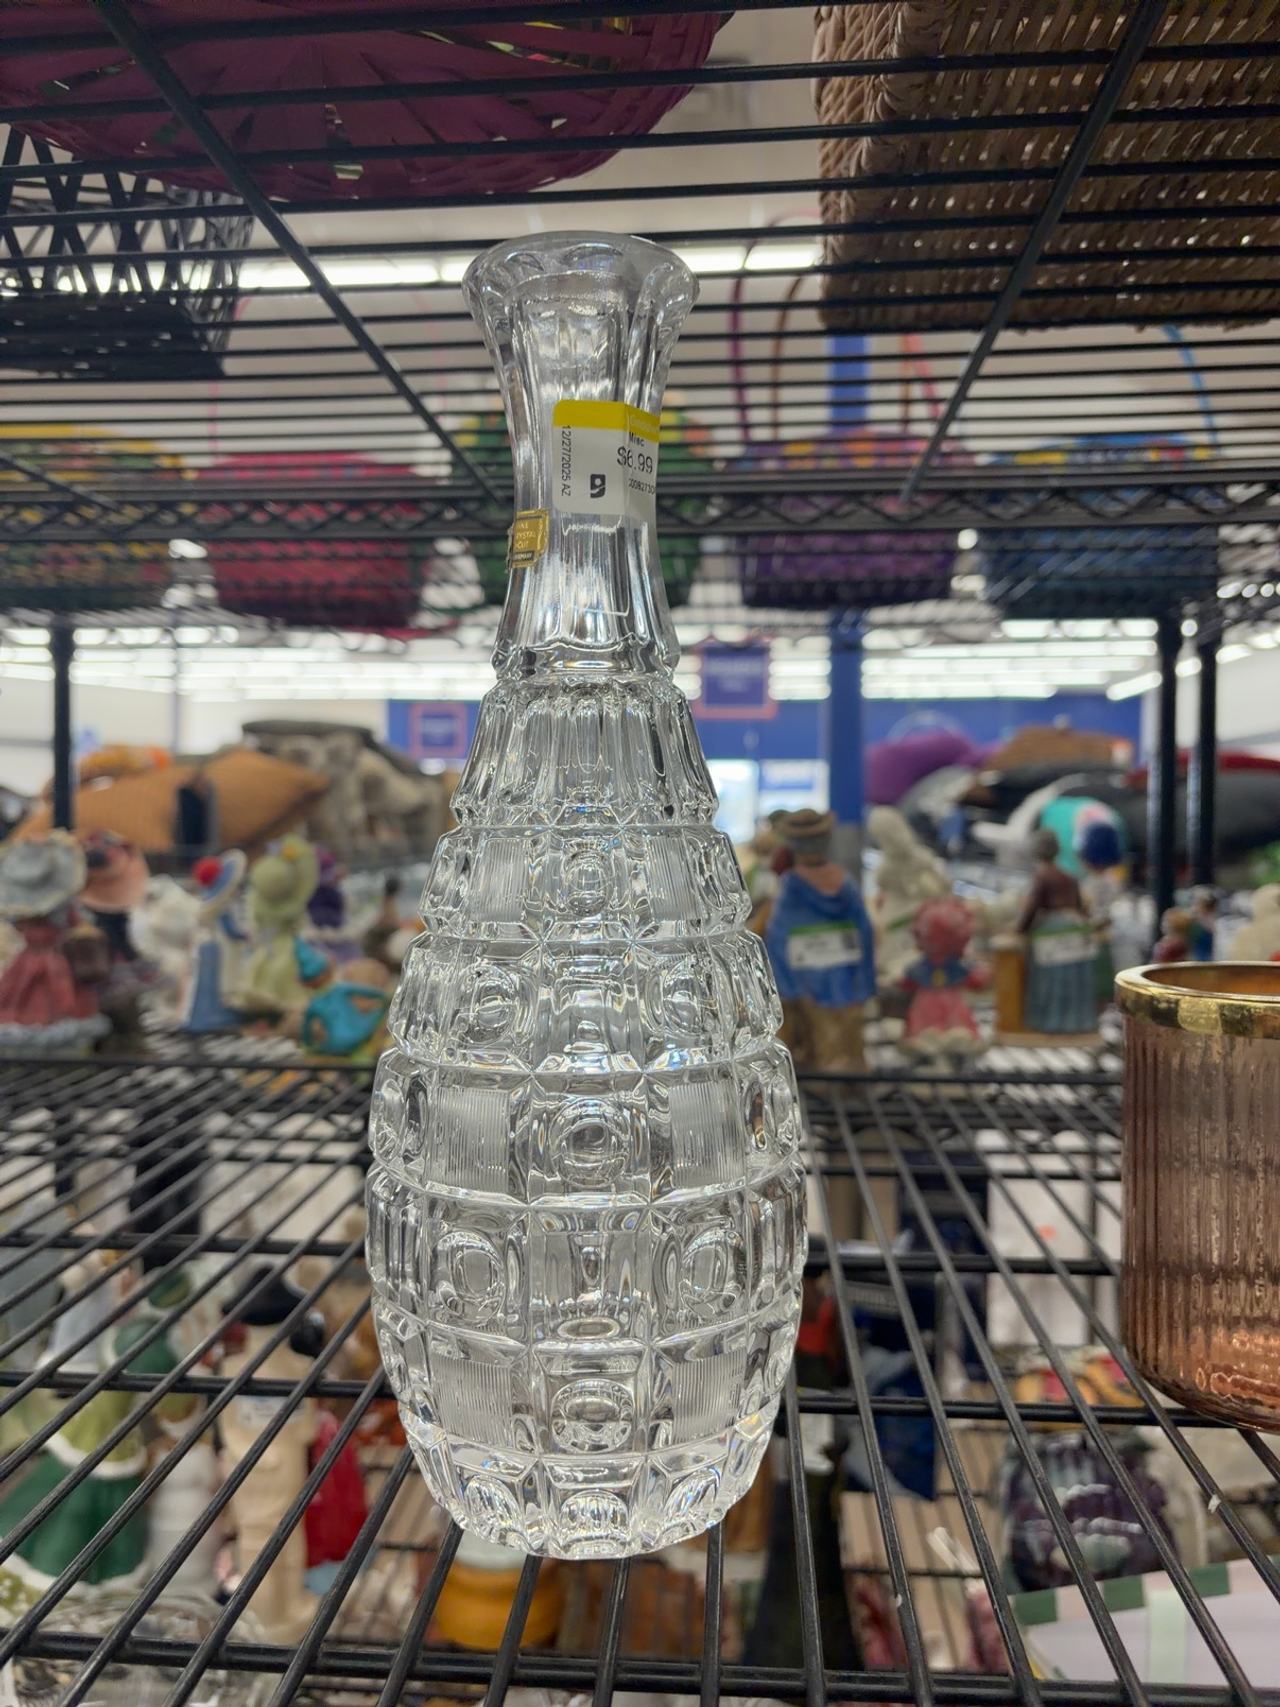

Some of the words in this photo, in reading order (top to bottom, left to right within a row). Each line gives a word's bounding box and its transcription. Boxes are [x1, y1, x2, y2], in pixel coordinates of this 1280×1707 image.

[561, 425, 572, 481] 12/27/2025
[617, 446, 653, 474] $6.99
[561, 484, 572, 497] AZ
